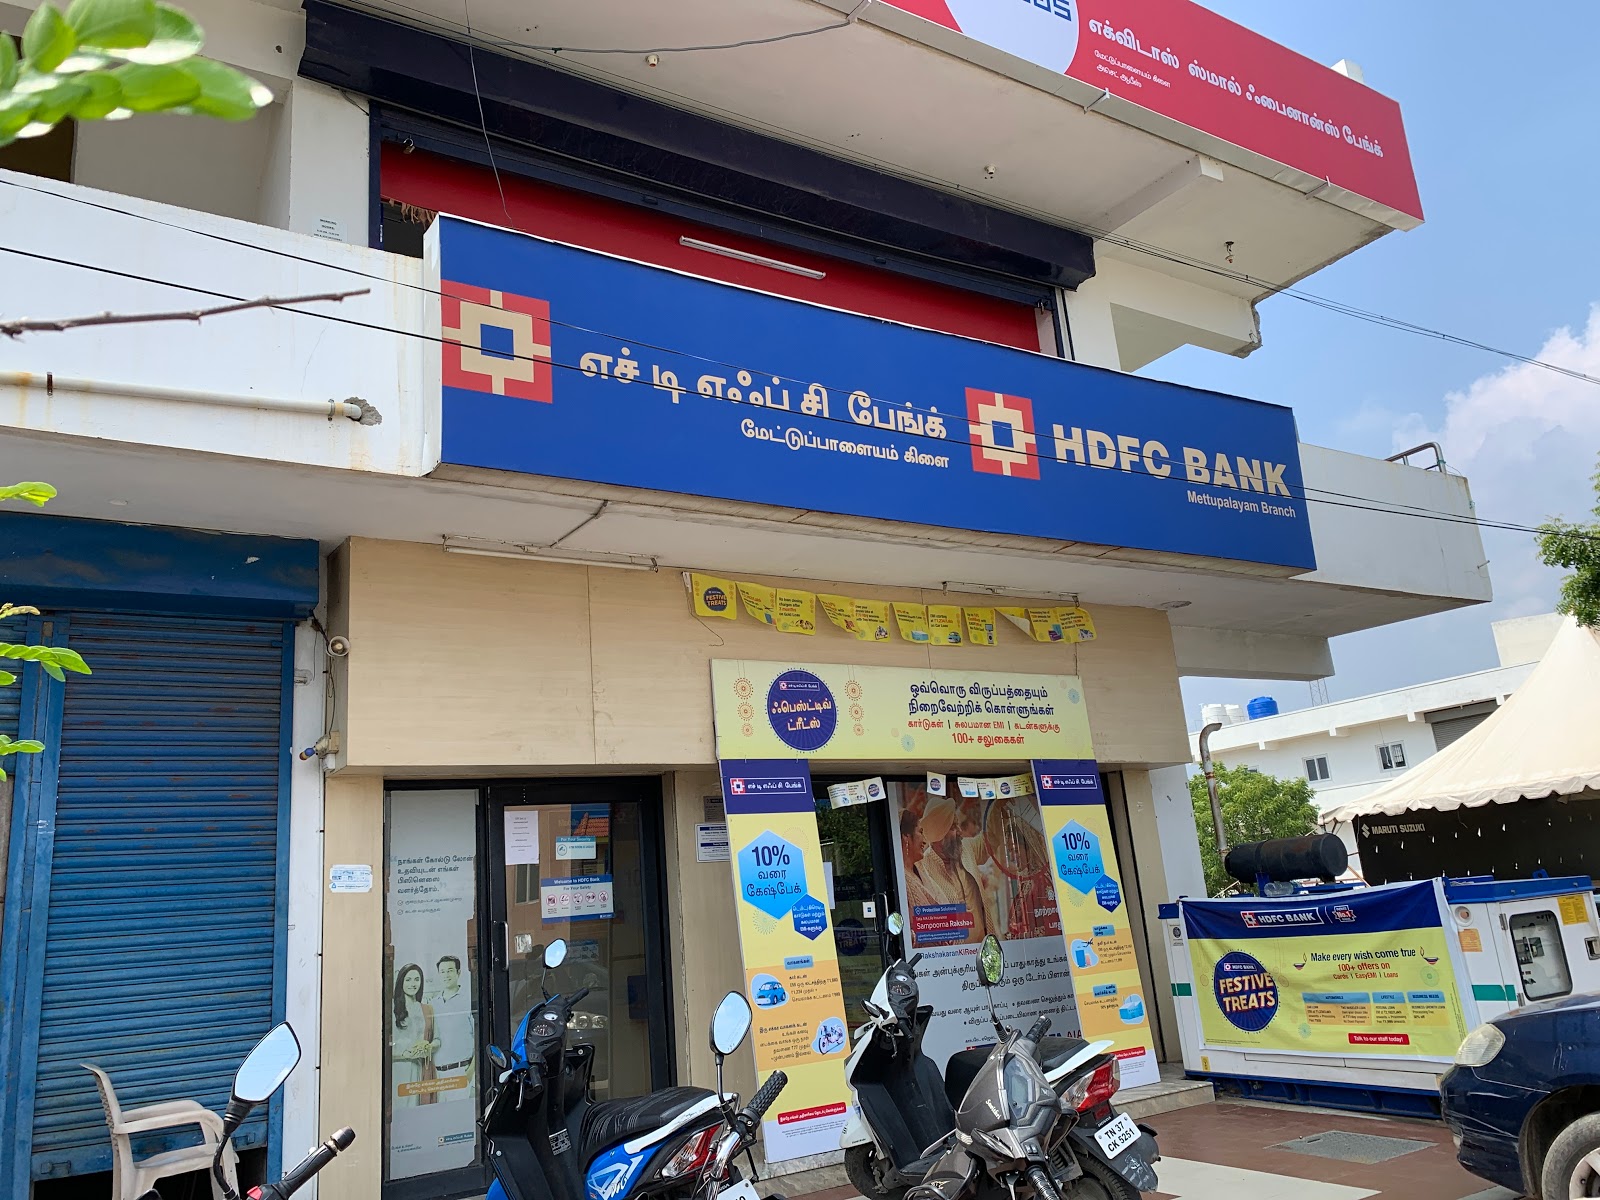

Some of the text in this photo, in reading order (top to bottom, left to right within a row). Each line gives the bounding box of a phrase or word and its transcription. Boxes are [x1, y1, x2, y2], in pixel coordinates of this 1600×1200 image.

[1089, 19, 1384, 158] எக்விடாஸ் ஸ்மால் ஃபைனான்ஸ் பேங்க்
[580, 347, 947, 440] எச் டி எஃப் சி பேங்க்
[741, 418, 949, 468] மேட்டுப்பாளையம் கிளை
[1052, 423, 1293, 499] HDFC BANK
[1186, 489, 1296, 518] Mettupalayam Branch
[910, 680, 1048, 700] ஒவ்வொரு விருப்பத்தையும்
[908, 698, 1054, 718] நிறைவேற்றிக் கொள்ளுங்கள்
[787, 716, 821, 731] ட்ரீட்ஸ்
[907, 718, 1060, 733] கார்டுகள் சுலபமான EMI கடன்களுக்கு
[952, 733, 1025, 747] 100+ சலுகைகள்
[1371, 823, 1426, 835] MARUTI SUZUKI
[1062, 832, 1090, 850] 10%
[397, 857, 423, 866] நாங்கள்
[424, 855, 451, 865] கோல்டு
[751, 844, 790, 867] 10%
[1068, 853, 1089, 861] வரை
[397, 864, 459, 876] உதவியுடன் எங்கள்
[757, 870, 786, 880] வரை
[1061, 863, 1101, 878] கேஷ்பேக்
[746, 882, 802, 899] கேஷ்பேக்
[917, 919, 973, 930] Sampoorna Raksha+
[1257, 914, 1285, 924] HDFC
[1285, 912, 1316, 922] BANK
[1310, 948, 1416, 962] Make every wish come true
[1337, 963, 1355, 972] 100+
[1357, 962, 1380, 971] offers
[1012, 977, 1025, 987] ஒரு
[1026, 971, 1047, 982] டேர்ம்
[1219, 972, 1275, 995] FESTIVE
[1355, 972, 1377, 980] EasyEMI
[1222, 990, 1276, 1012] TREATS
[1104, 1121, 1125, 1140] TN 37
[1107, 1127, 1135, 1152] CK 5251
